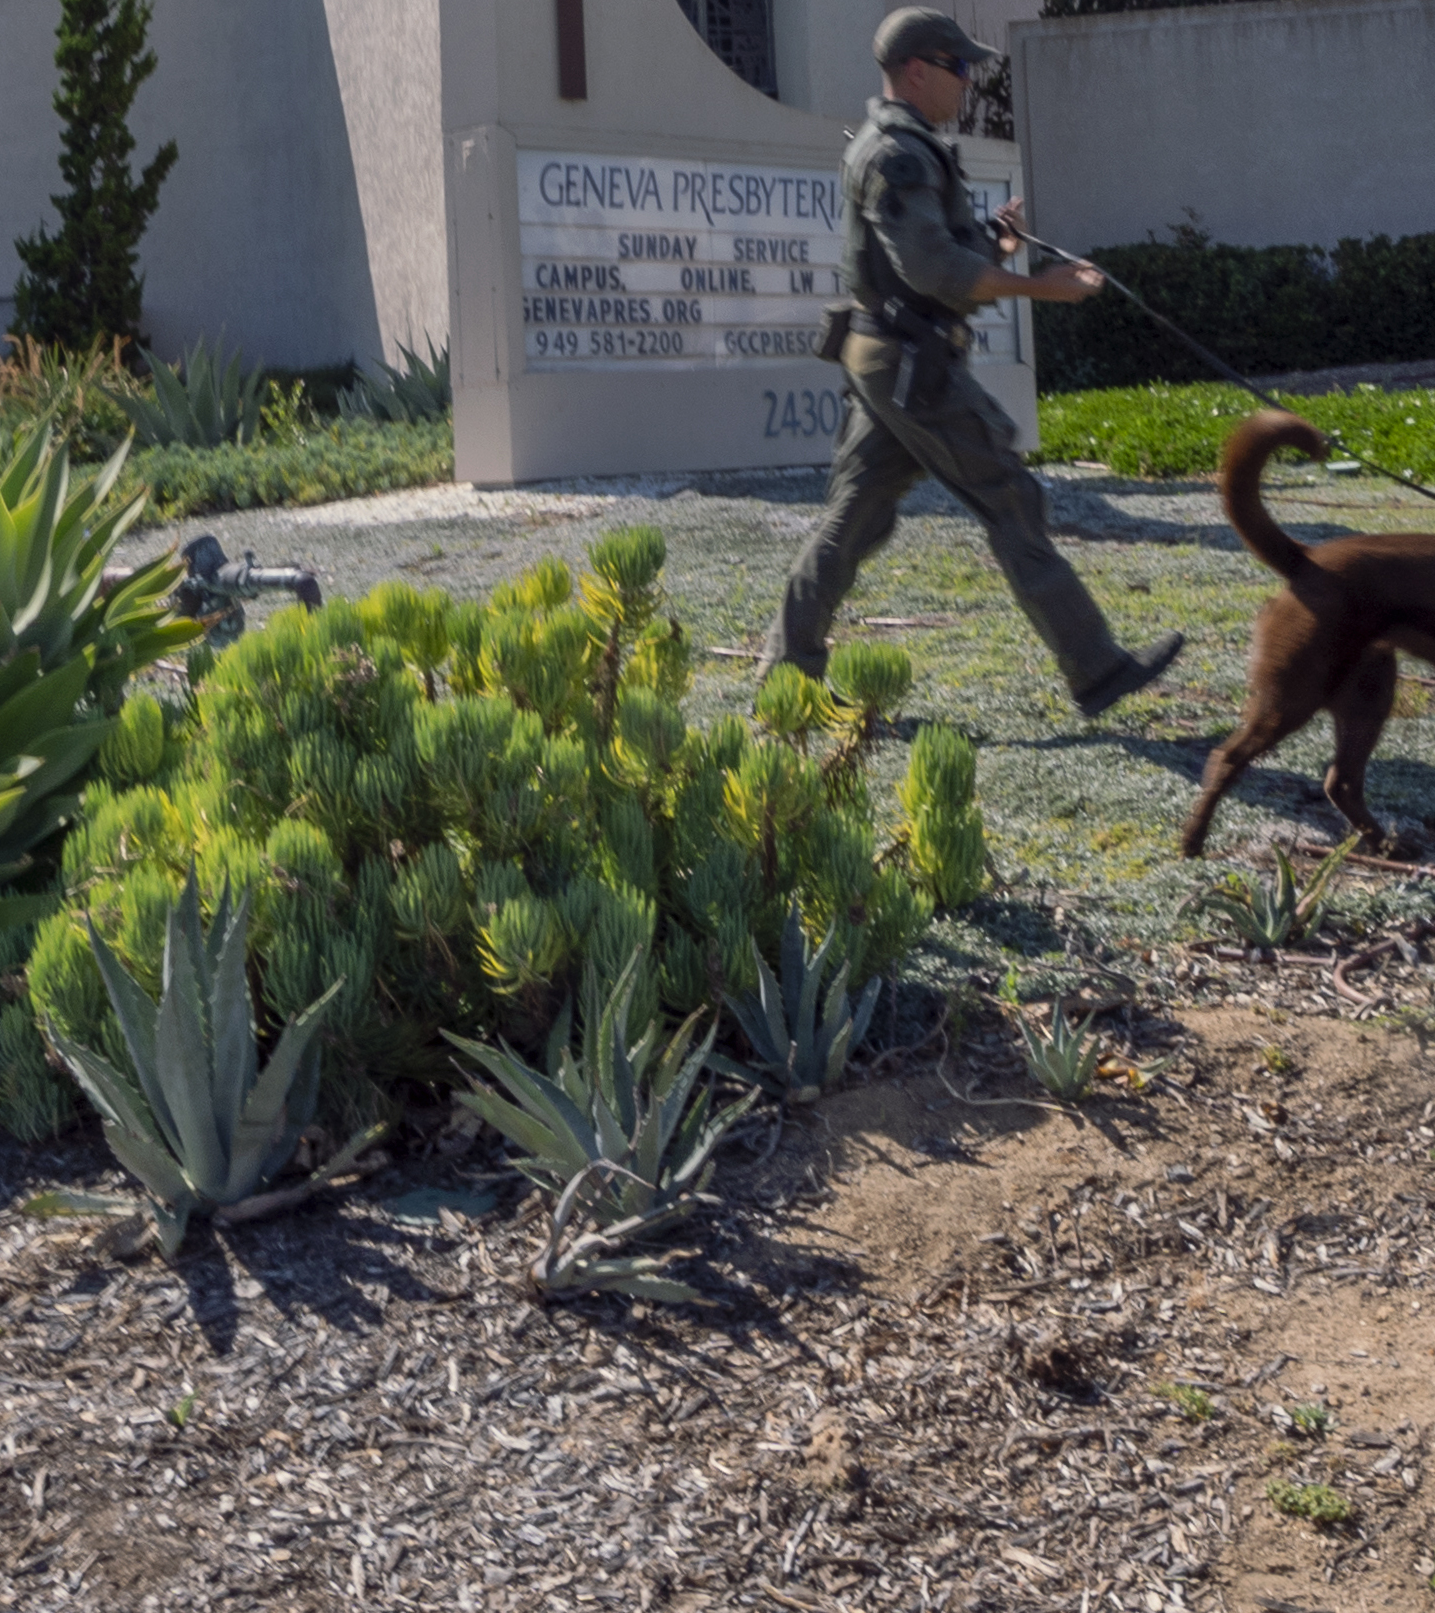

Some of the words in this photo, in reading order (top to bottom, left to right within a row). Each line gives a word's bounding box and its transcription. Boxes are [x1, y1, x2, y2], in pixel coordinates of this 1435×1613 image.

[539, 162, 664, 212] GENEVA
[672, 170, 844, 232] PRESBYTERI
[618, 233, 697, 260] SUNDAY
[733, 237, 810, 264] SERVICE
[535, 262, 627, 292] CAMPUS,
[680, 266, 757, 294] ONLINE,
[790, 269, 814, 294] LW
[536, 330, 579, 356] 949
[590, 329, 684, 356] 581-2200
[764, 389, 846, 438] 2430
